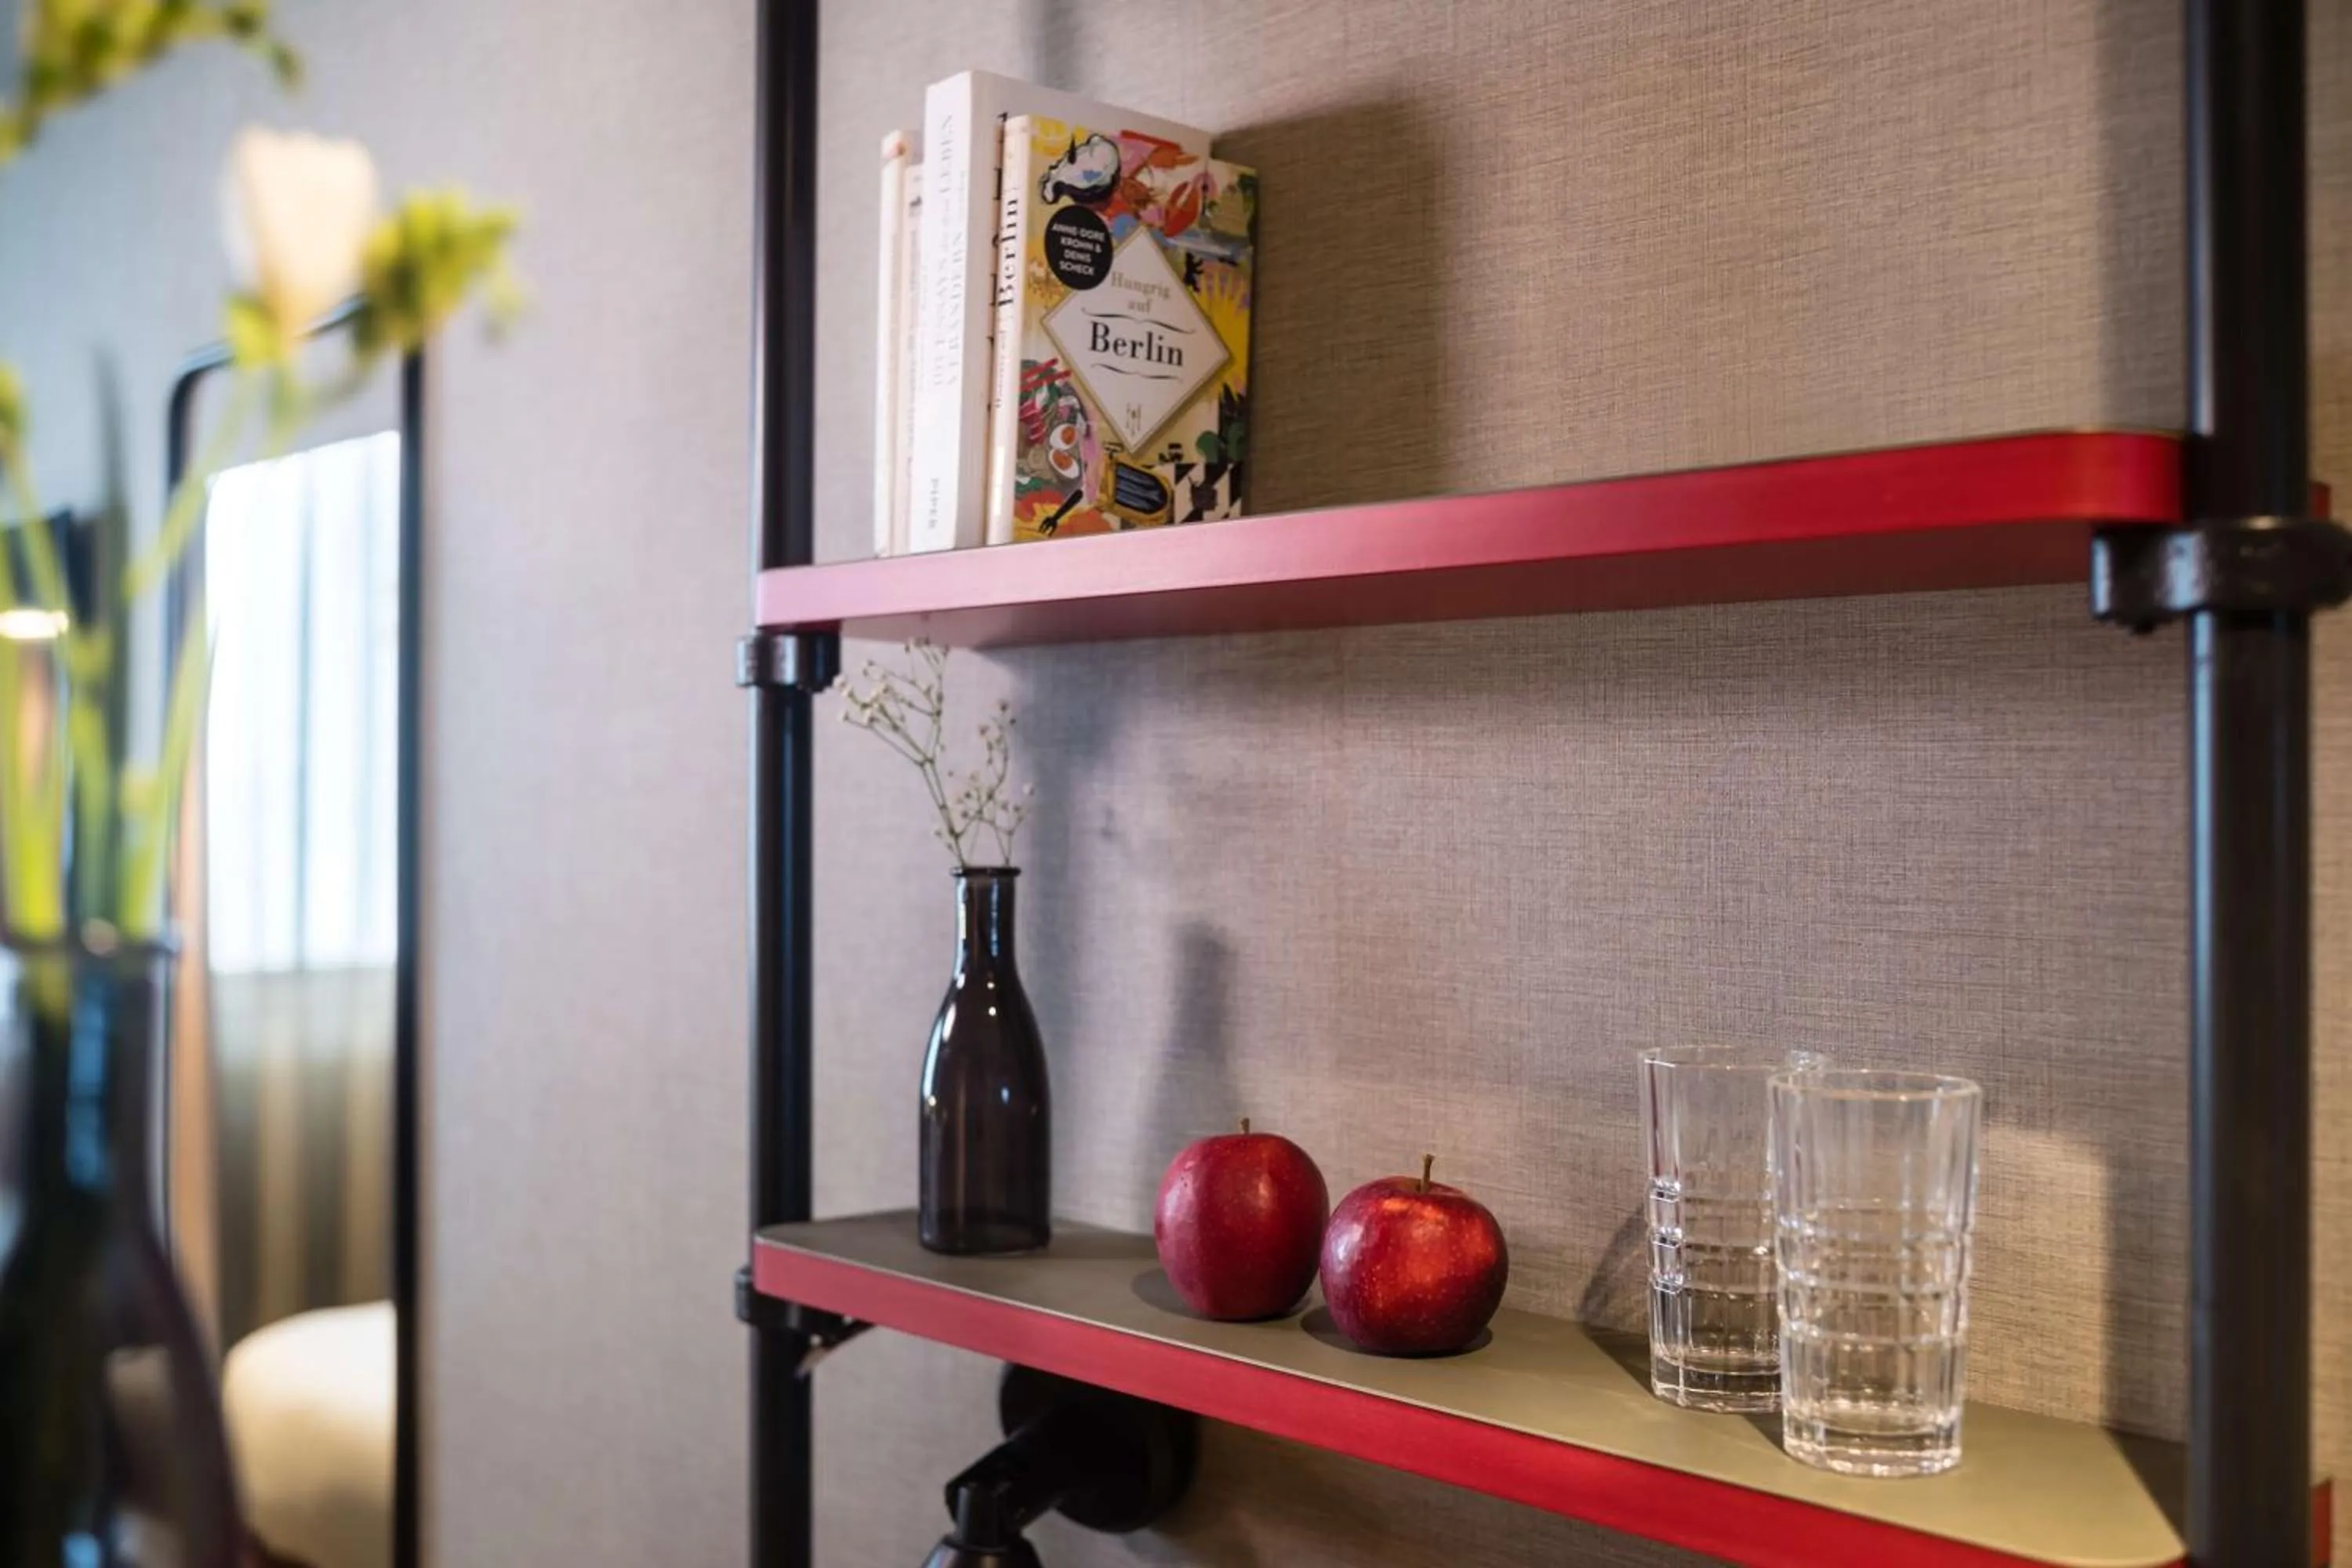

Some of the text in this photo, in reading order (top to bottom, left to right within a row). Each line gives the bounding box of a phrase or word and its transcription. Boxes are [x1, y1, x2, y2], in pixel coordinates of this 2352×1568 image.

[997, 198, 1018, 308] Berlin
[1059, 260, 1094, 276] SCHECK
[1111, 270, 1170, 299] Hungrig
[1129, 299, 1152, 314] auf
[1088, 320, 1183, 367] Berlin
